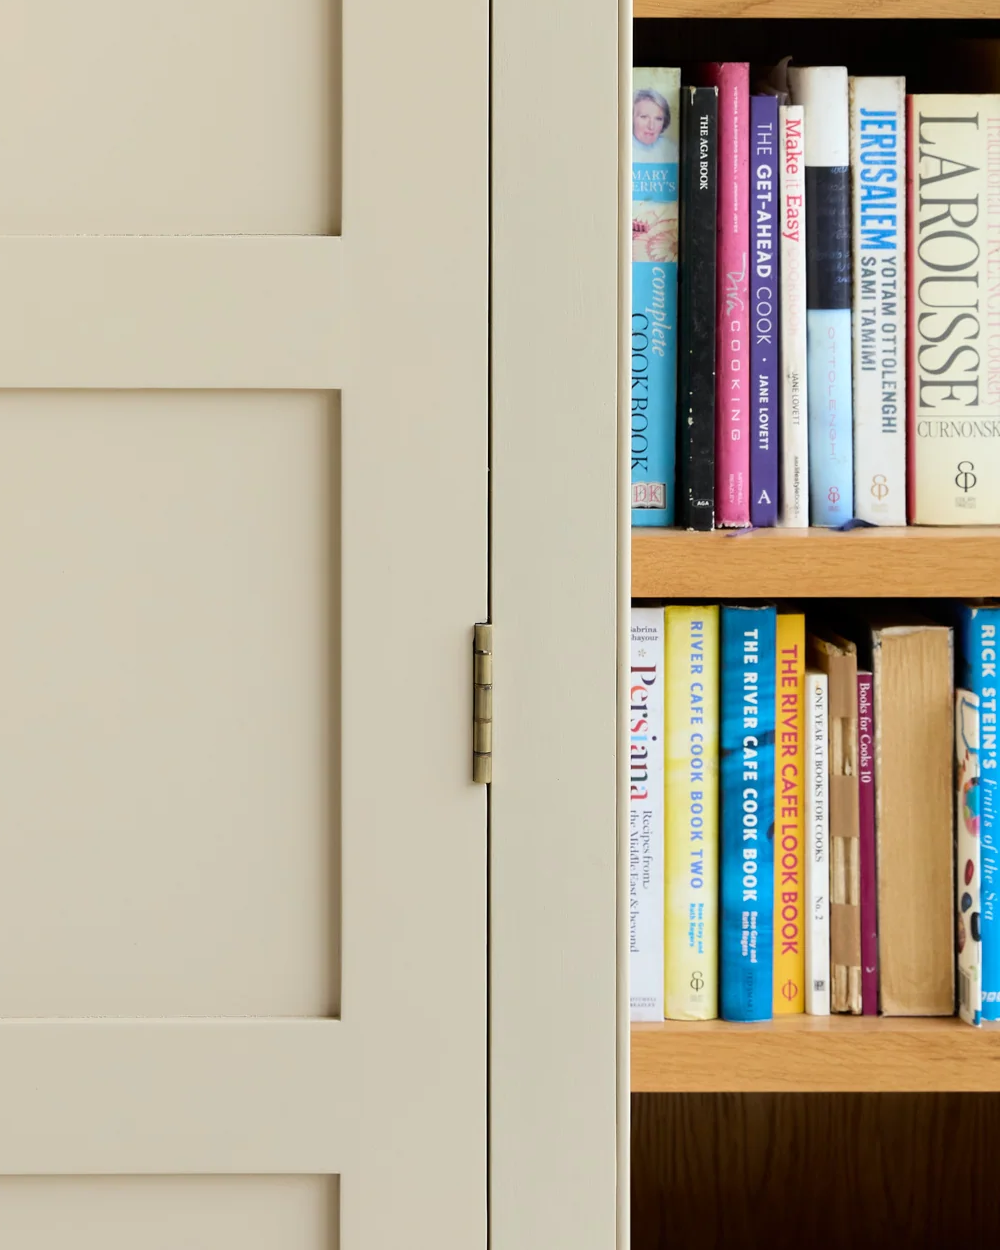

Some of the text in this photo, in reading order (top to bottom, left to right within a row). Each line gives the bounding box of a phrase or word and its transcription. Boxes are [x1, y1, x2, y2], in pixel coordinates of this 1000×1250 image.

[632, 169, 668, 180] MARY
[700, 115, 708, 190] THE AGA BOOK
[786, 119, 802, 174] Make
[860, 108, 897, 250] JERUSALEM
[633, 181, 676, 192] ERRY'S
[782, 195, 802, 242] Easy
[786, 179, 801, 190] it
[756, 123, 772, 344] THE GET-AHEAD COOK
[917, 112, 980, 408] LAROUSSE
[645, 267, 671, 357] complete
[726, 252, 747, 441] Diva COOKING
[861, 257, 876, 371] SAMI TAMIMI
[881, 256, 897, 434] YOTAM OTTOLENGHI
[759, 375, 768, 450] JANE LOVETT
[827, 327, 836, 460] OTTOLENGHI
[634, 485, 661, 503] DK
[981, 625, 995, 677] RICK
[631, 665, 657, 801] Persiana
[690, 621, 703, 889] RIVER CAFE COOK BOOK TWO
[742, 629, 758, 902] THE RIVER CAFE COOK BOOK
[859, 683, 871, 782] Books for Cooks 10
[782, 645, 798, 955] THE RIVER CAFE LOOK BOOK
[815, 688, 823, 862] ONE YEAR AT BOOKS FOR COOKS
[983, 778, 998, 827] Fruits
[641, 811, 652, 889] Recipes from
[981, 835, 997, 853] of
[985, 858, 997, 883] the
[688, 922, 696, 947] Rogers
[749, 931, 757, 948] Gray
[815, 896, 823, 912] No.
[985, 891, 997, 921] Sea
[741, 931, 749, 956] Rogers
